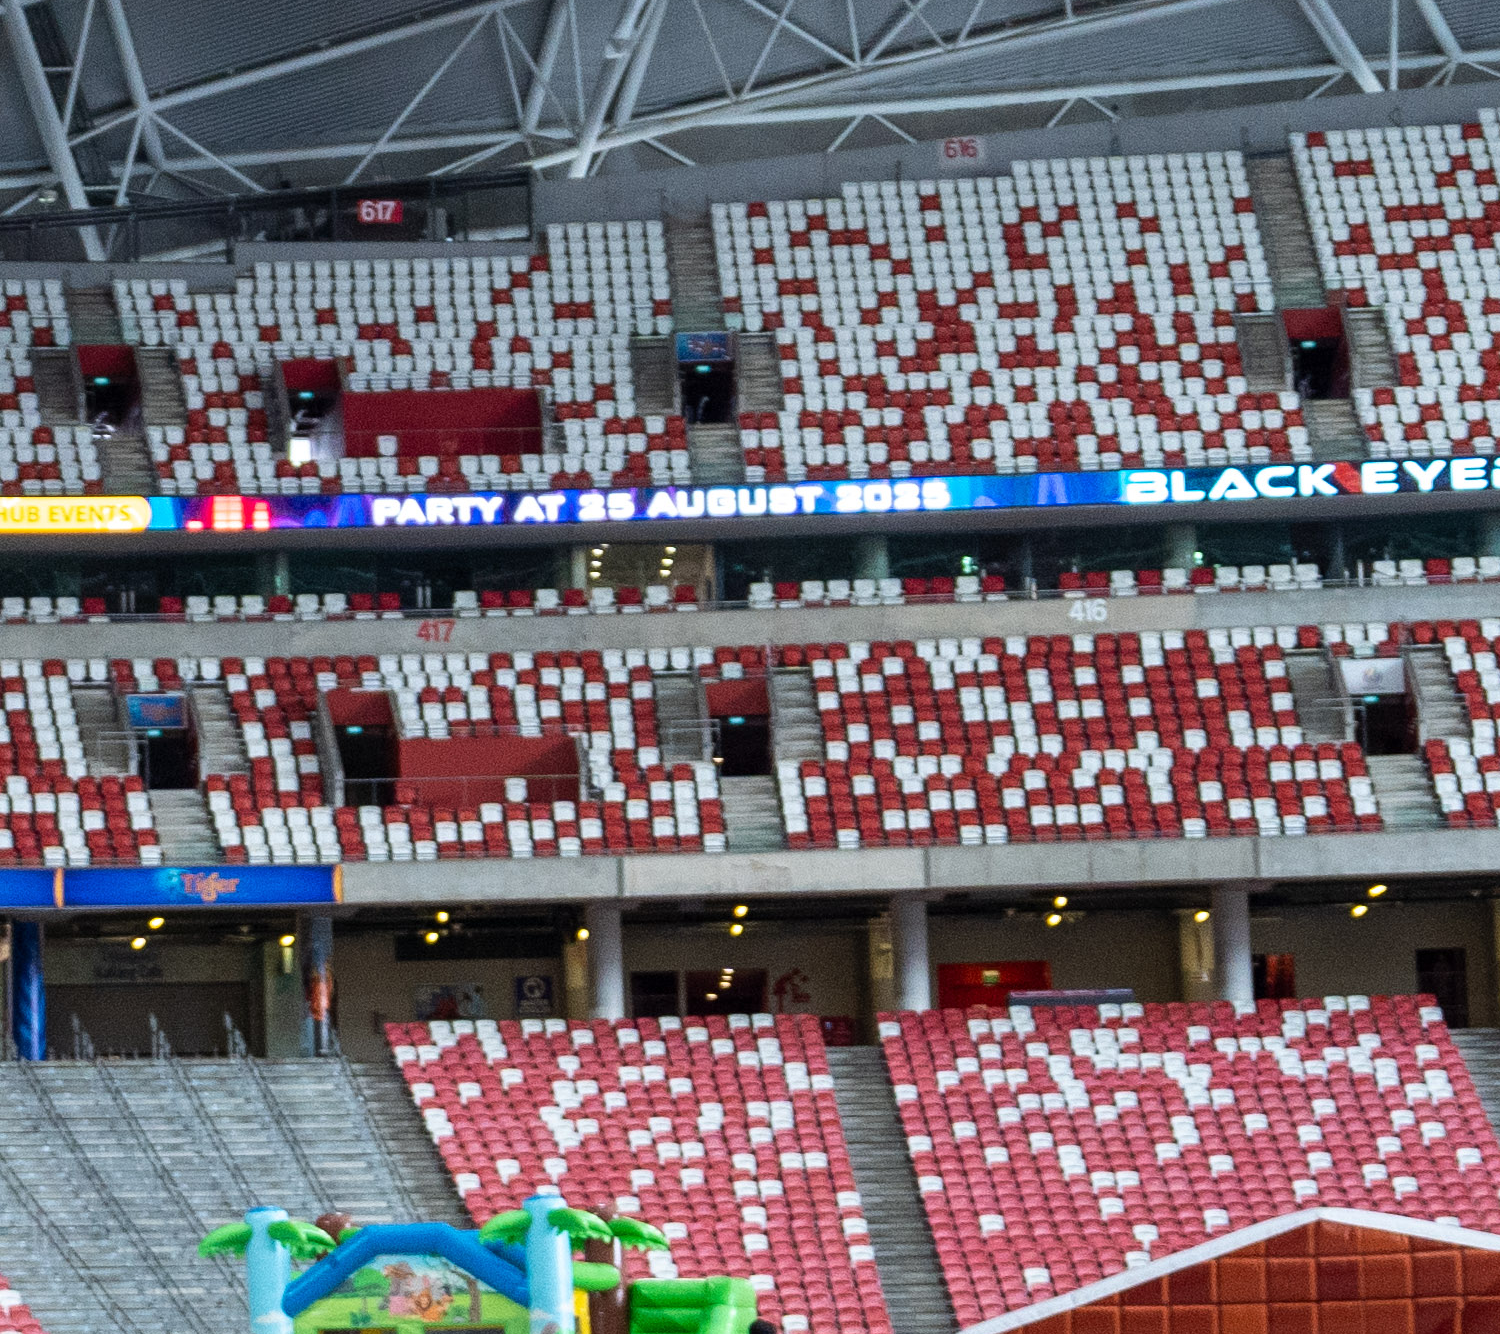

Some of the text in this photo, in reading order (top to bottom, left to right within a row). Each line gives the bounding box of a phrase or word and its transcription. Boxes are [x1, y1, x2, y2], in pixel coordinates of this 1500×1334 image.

[943, 138, 978, 159] 616
[360, 200, 396, 221] 617
[1125, 463, 1338, 504] BLACK
[48, 505, 131, 523] EVENTS
[373, 481, 951, 525] PARTY AT 25 AUGUST 2025
[1069, 598, 1108, 622] 416
[415, 618, 456, 644] 417
[180, 871, 240, 904] Tiger
